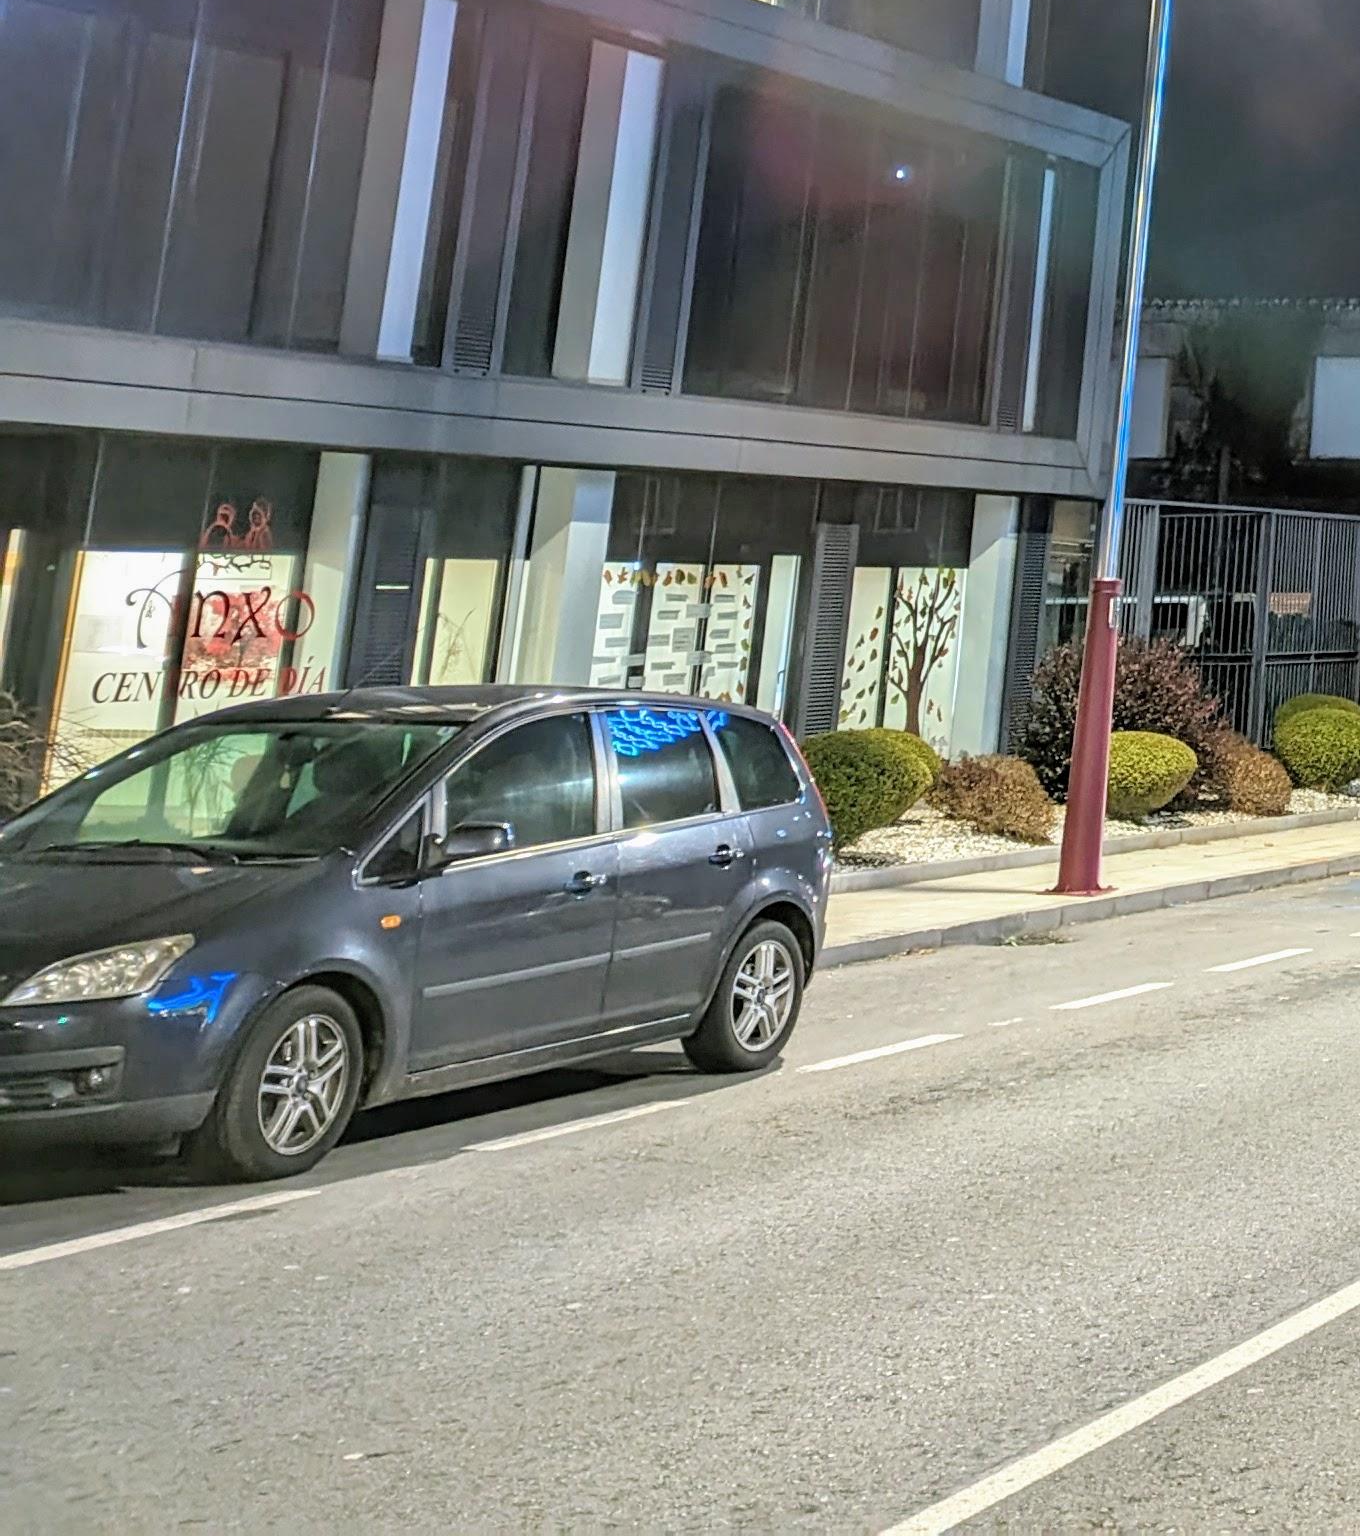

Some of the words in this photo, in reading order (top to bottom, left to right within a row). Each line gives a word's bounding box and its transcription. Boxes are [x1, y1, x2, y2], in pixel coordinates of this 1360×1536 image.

[92, 668, 221, 704] CENRO
[226, 668, 272, 698] DE
[279, 656, 327, 696] DÍA
